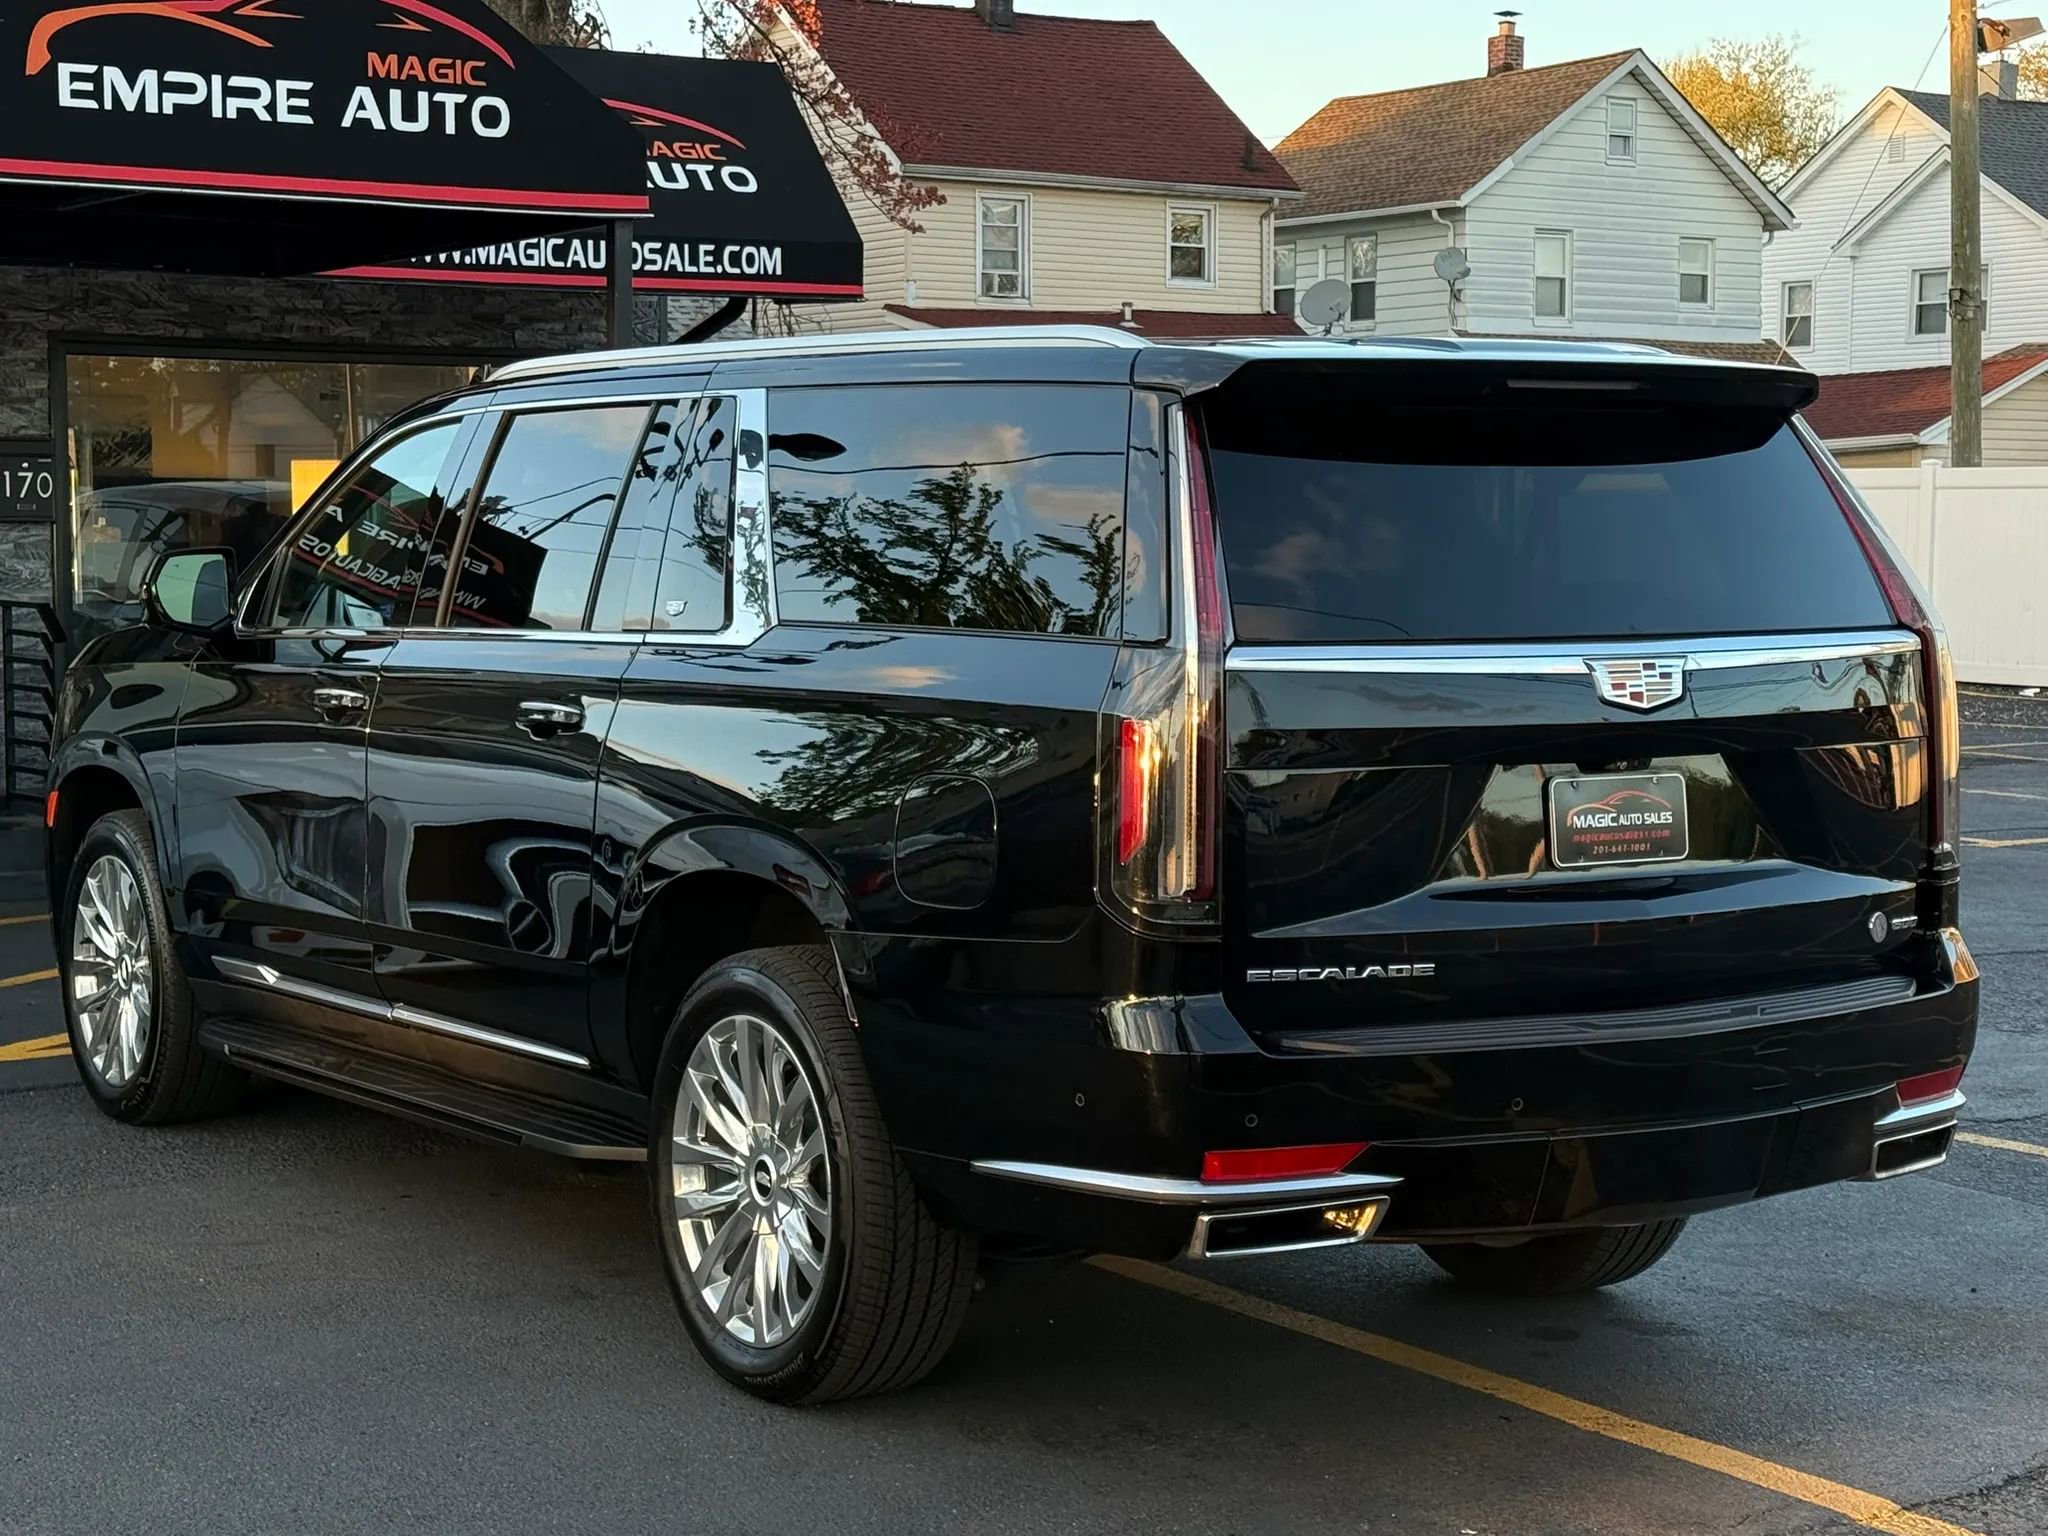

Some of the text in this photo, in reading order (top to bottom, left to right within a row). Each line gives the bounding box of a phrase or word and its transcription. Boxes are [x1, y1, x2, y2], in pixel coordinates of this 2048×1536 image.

[367, 51, 488, 86] MAGIC
[57, 62, 511, 138] EMPIRE AUTO
[647, 140, 727, 160] AGIC
[647, 161, 759, 193] UTO
[4, 471, 53, 498] 170
[1573, 811, 1673, 829] MAGIC AUTO SALES
[1246, 964, 1436, 982] ESCALADE
